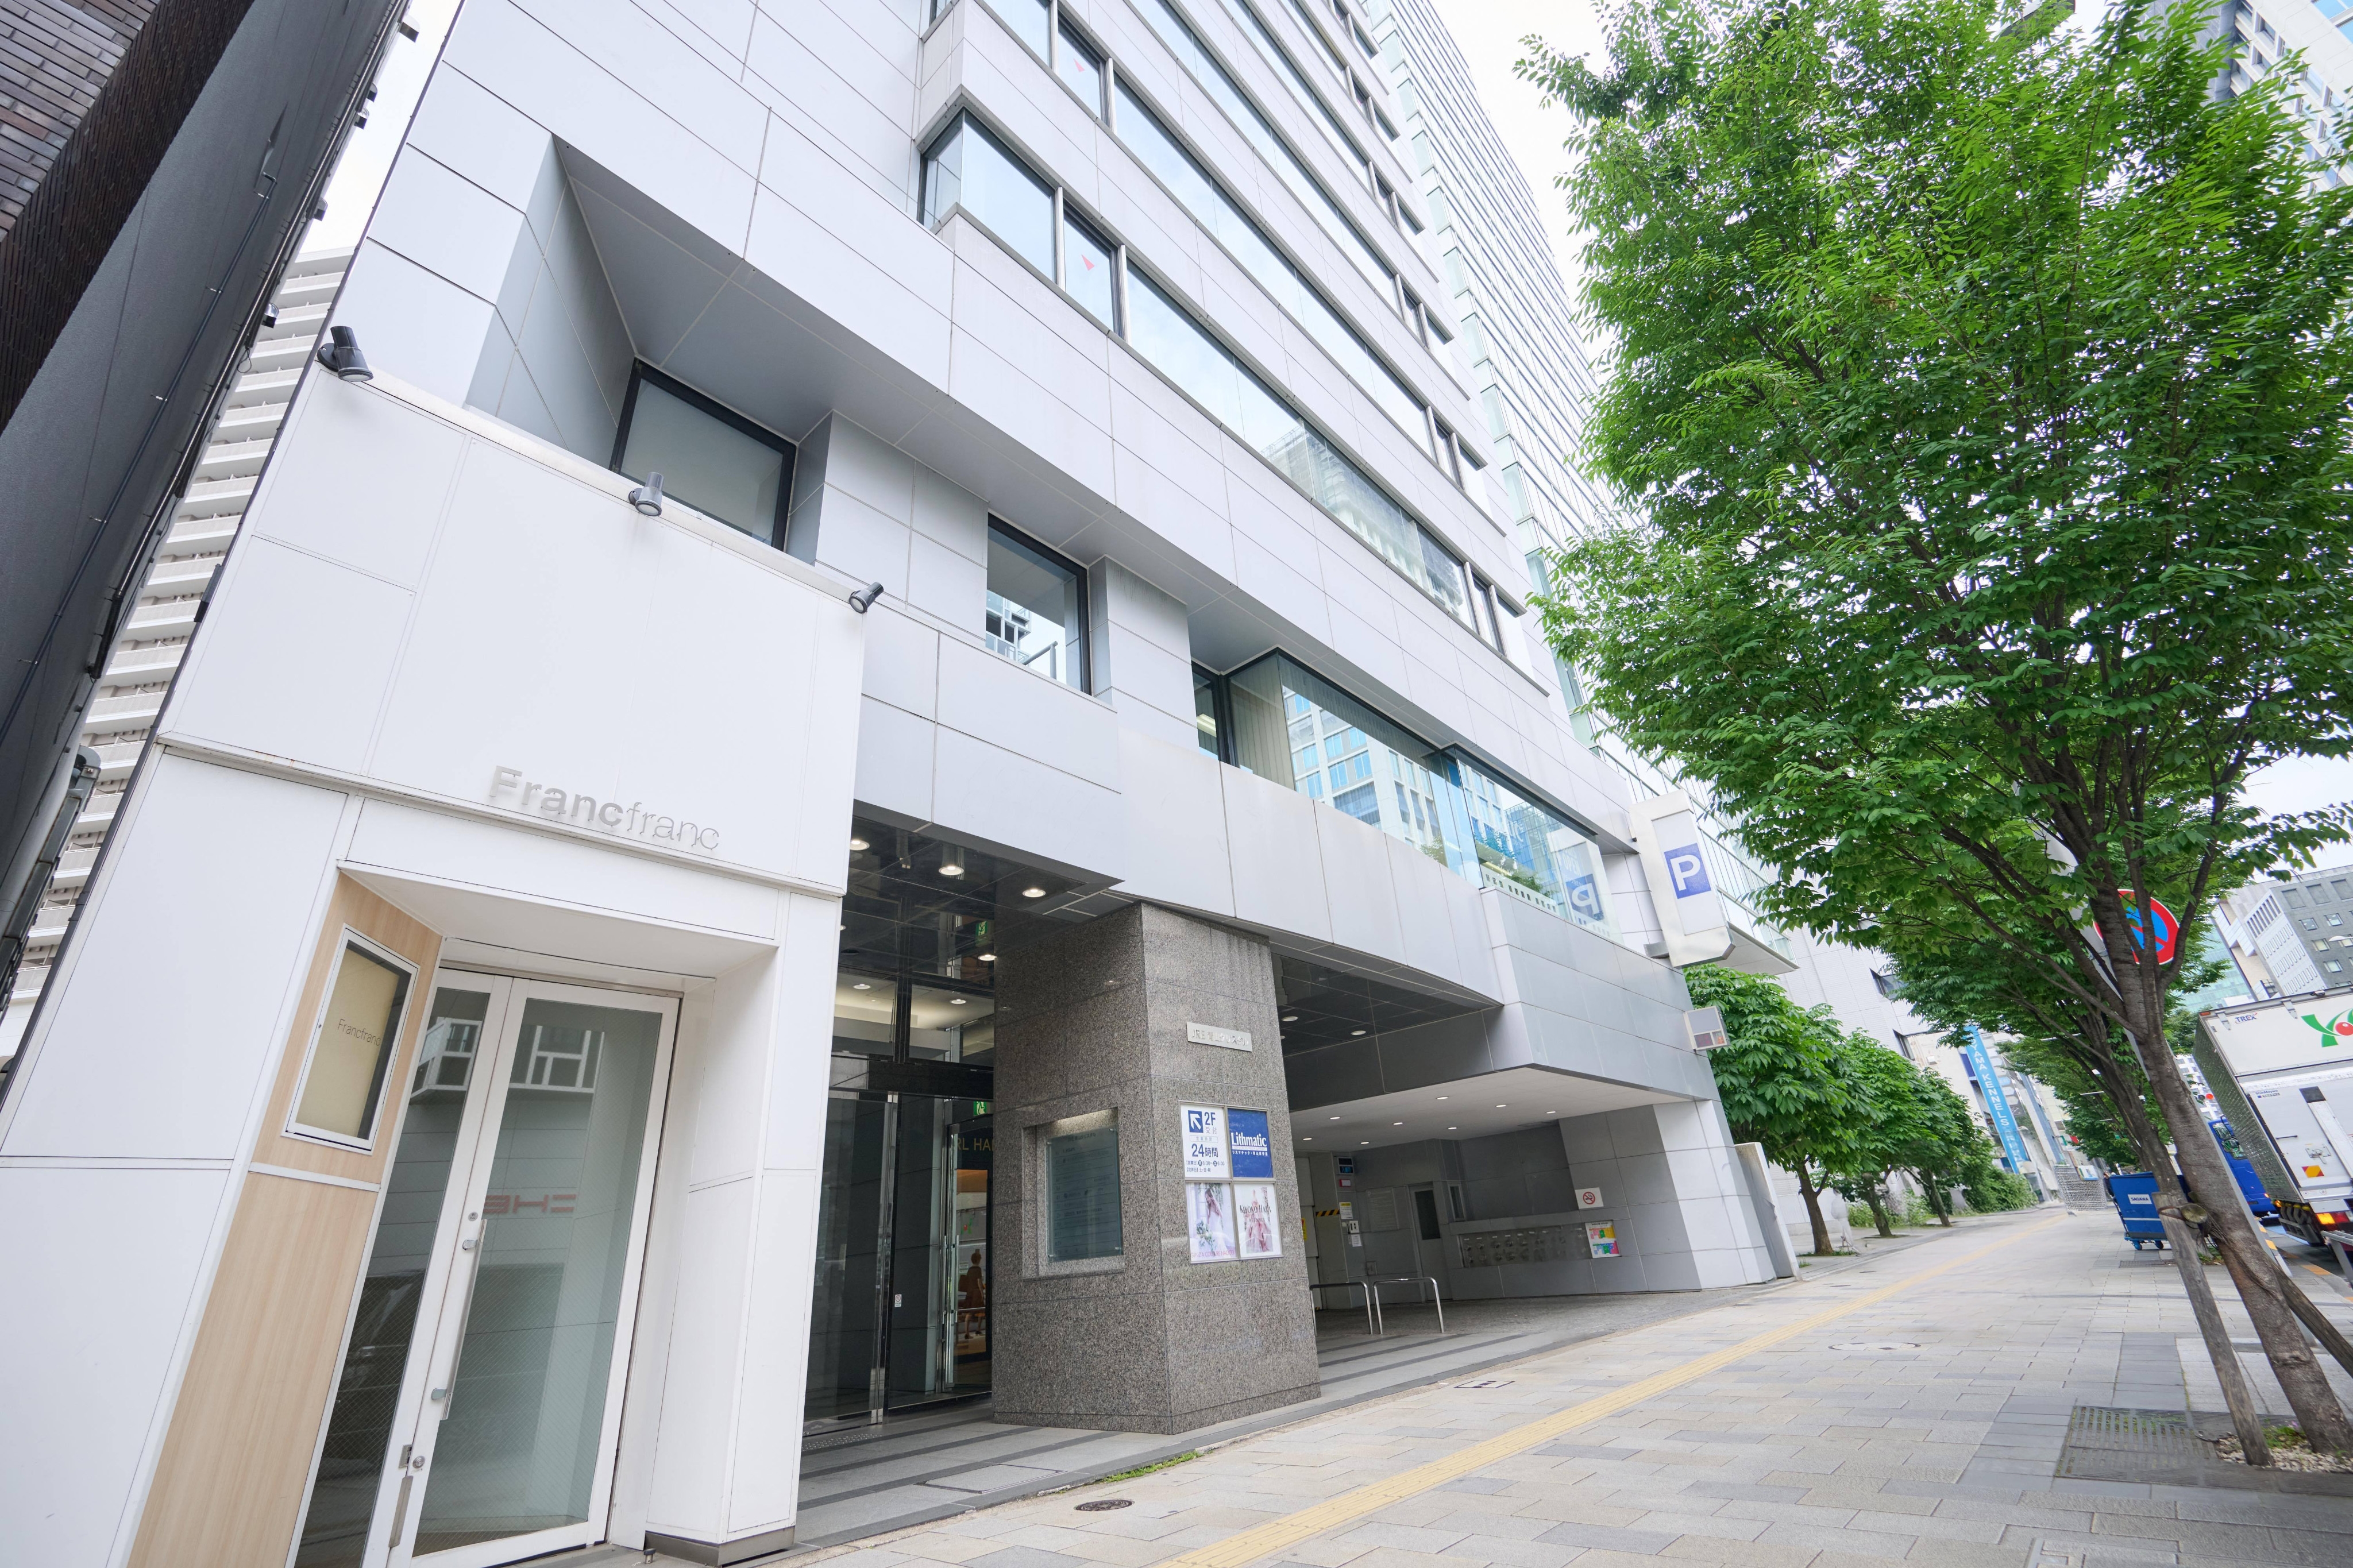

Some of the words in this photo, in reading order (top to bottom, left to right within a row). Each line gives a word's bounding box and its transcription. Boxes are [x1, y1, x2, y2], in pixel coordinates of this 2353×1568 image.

[489, 765, 719, 850] Francfranc
[1671, 855, 1701, 891] P
[337, 1018, 381, 1046] Francfranc
[1192, 1029, 1206, 1040] JRE
[1982, 1073, 2010, 1126] KENNELS
[1204, 1111, 1216, 1126] 2F
[1191, 1143, 1218, 1157] 24時間
[1230, 1131, 1267, 1147] Lithmatic
